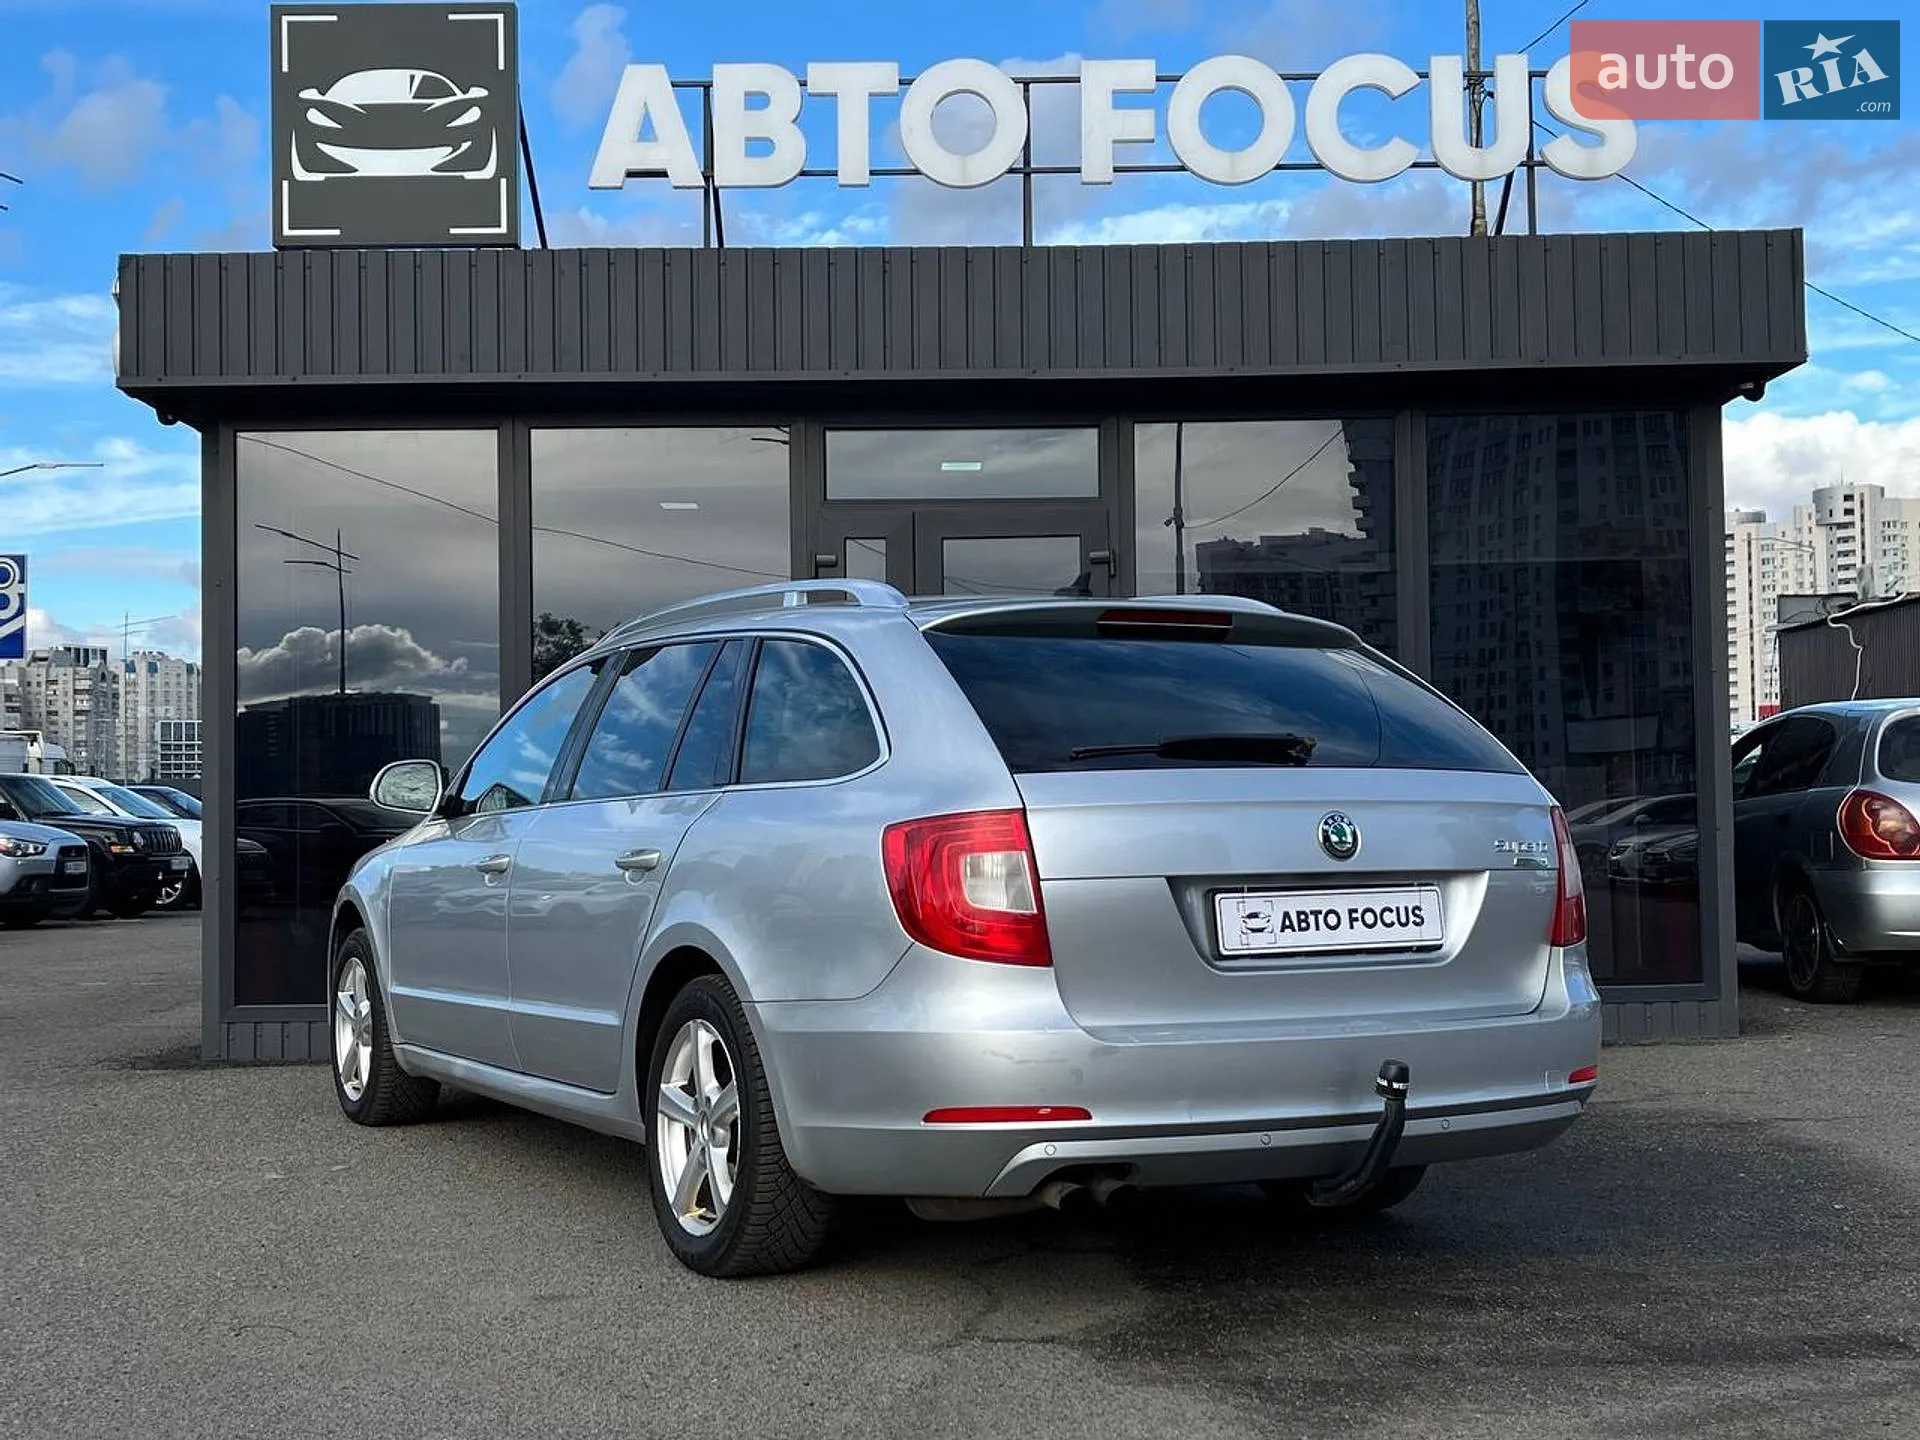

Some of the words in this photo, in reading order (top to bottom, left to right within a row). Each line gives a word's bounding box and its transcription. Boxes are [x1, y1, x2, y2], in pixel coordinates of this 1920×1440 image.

[588, 58, 1028, 190] АВТО
[1080, 53, 1639, 186] FOCUS
[1280, 908, 1341, 933] АВТО
[1347, 905, 1425, 930] FOCUS
